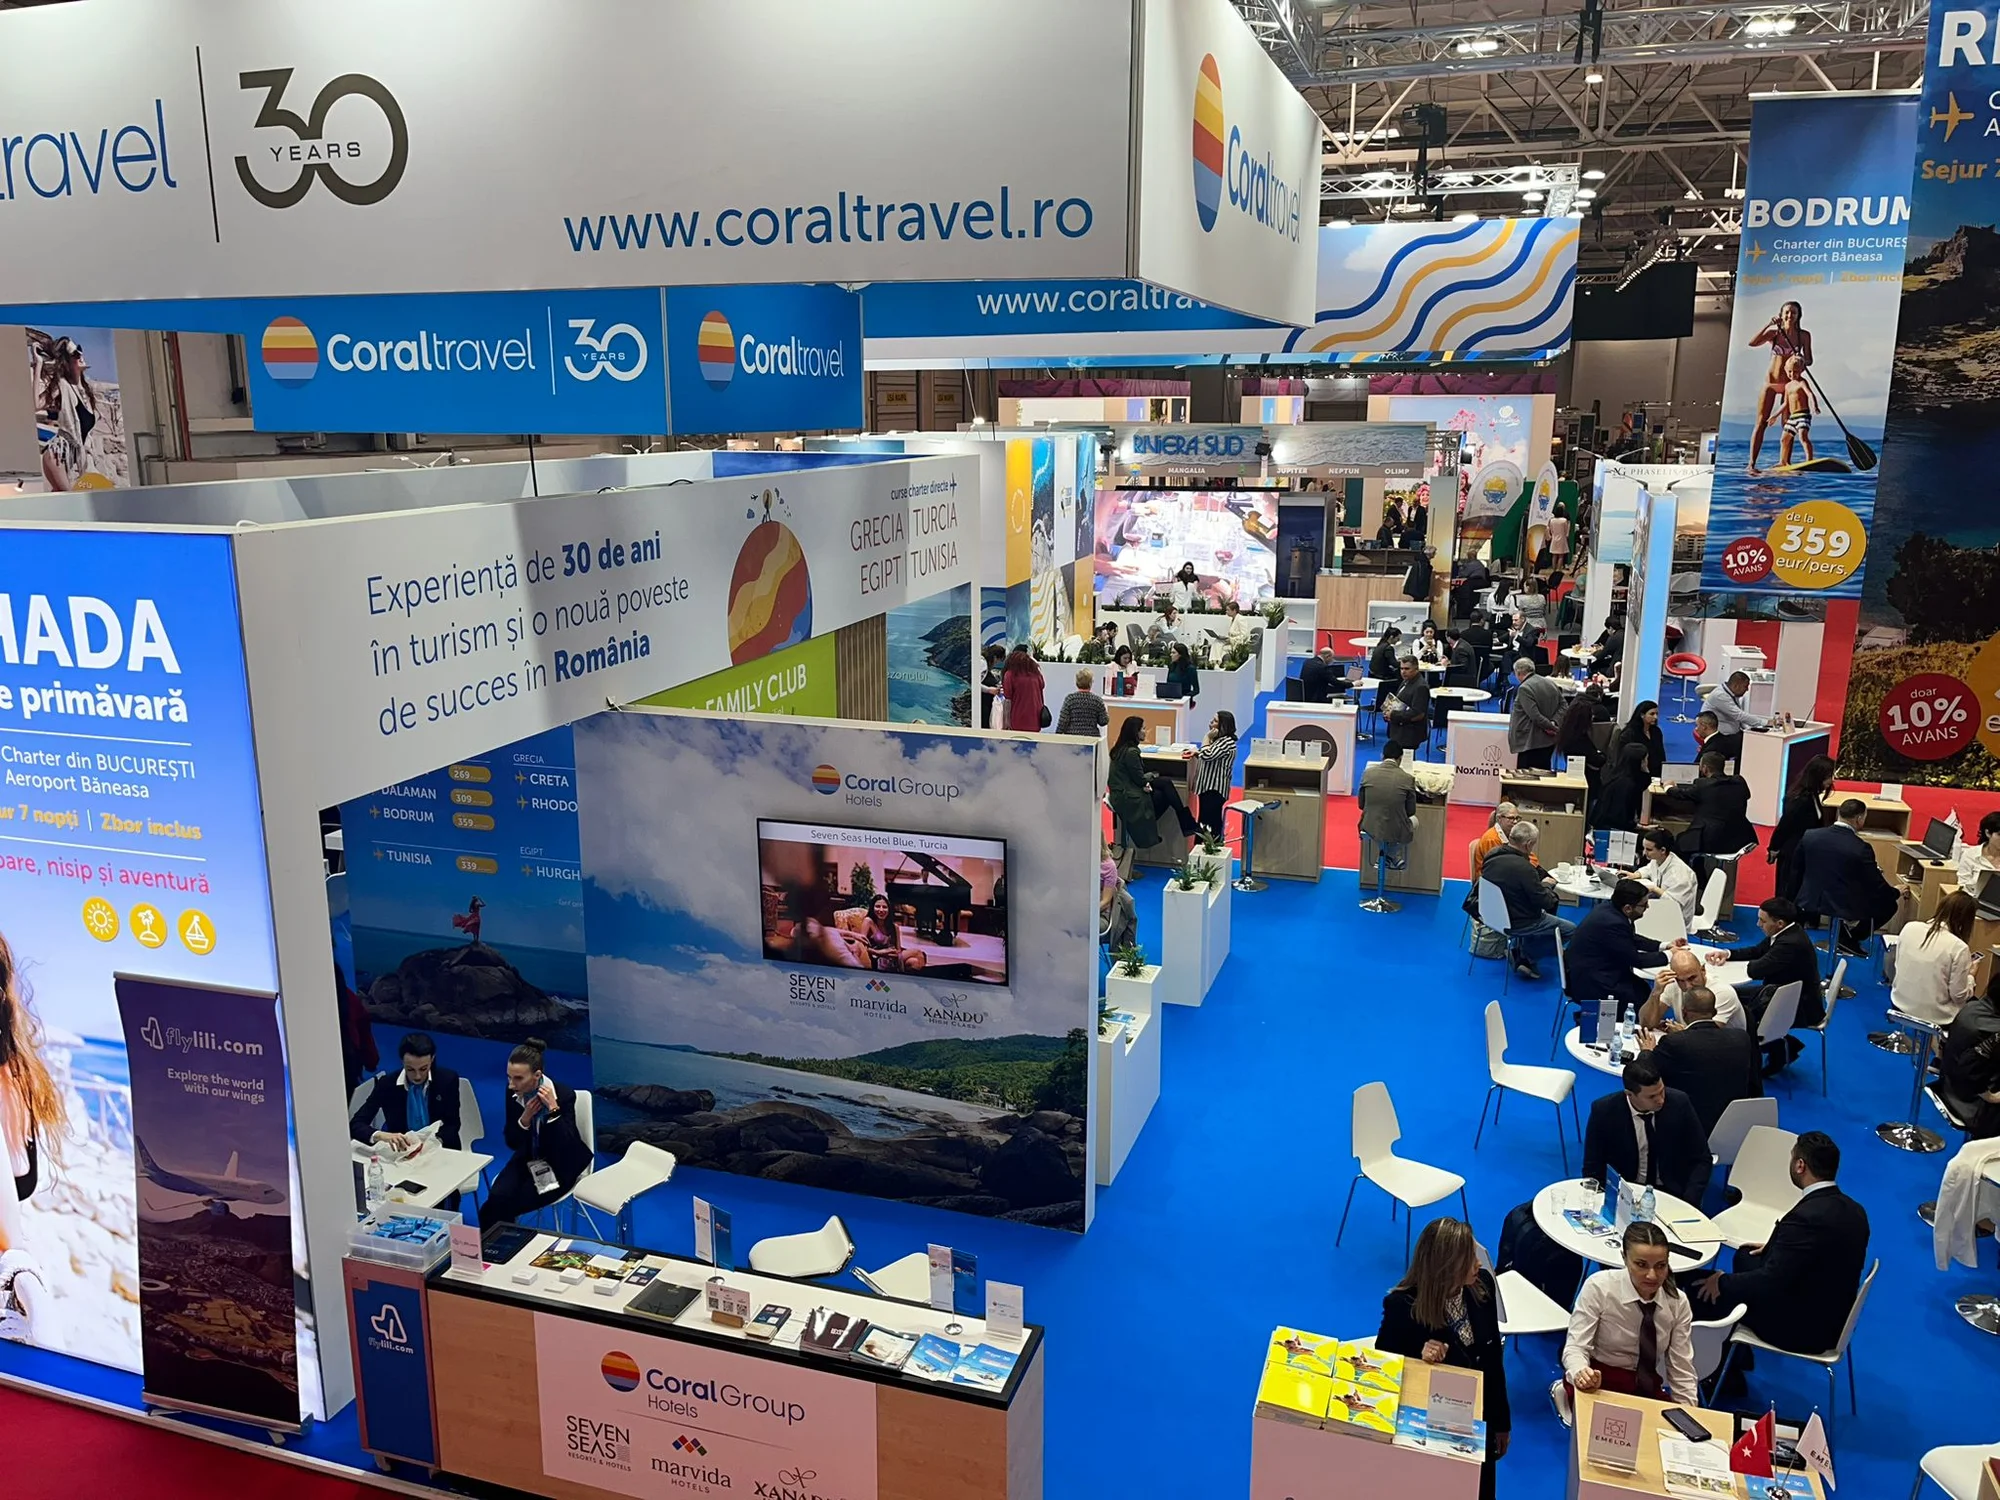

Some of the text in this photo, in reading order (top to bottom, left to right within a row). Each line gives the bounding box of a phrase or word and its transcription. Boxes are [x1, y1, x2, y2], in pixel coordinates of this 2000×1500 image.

[0, 98, 177, 200] ravel
[270, 140, 362, 163] YEARS
[1921, 160, 1988, 184] Sejur
[562, 186, 1094, 252] www.coraltravel.ro
[1773, 238, 1820, 250] Charter
[1824, 237, 1844, 249] din
[1771, 251, 1883, 264] Aeroport Băneasa
[326, 327, 535, 373] Coraltravel
[581, 352, 626, 362] YEARS
[740, 334, 845, 379] Coraltravel
[1203, 434, 1245, 457] SUD
[1328, 467, 1360, 475] NEPTUN
[1384, 467, 1410, 475] OLIMP
[890, 480, 949, 501] curse charter directe
[850, 501, 958, 552] GRECIA TURCIA
[1786, 511, 1815, 524] de la
[1779, 524, 1852, 559] 359
[860, 540, 958, 595] EGIPT TUNISIA
[1725, 547, 1767, 569] 10%
[1775, 556, 1848, 577] eur/pers.
[367, 530, 661, 618] Experiență de 30 de ani
[1732, 563, 1763, 577] AVANS
[370, 576, 689, 677] în turism și o nouă poveste
[379, 630, 651, 736] de succes în România
[766, 663, 807, 702] CLUB
[1910, 686, 1938, 700] doar
[20, 679, 189, 724] primăvară
[1886, 694, 1968, 733] 10%
[1902, 725, 1959, 746] AVANS
[1, 745, 196, 782] Charter din BUCUREȘTI
[513, 753, 545, 764] GRECIA
[5, 770, 150, 799] Aeroport Băneasa
[453, 770, 470, 779] 269
[529, 772, 570, 788] CRETA
[381, 785, 437, 800] DALAMAN
[845, 794, 882, 808] Hotels
[18, 803, 29, 821] 7
[32, 808, 80, 831] nopți
[100, 812, 145, 834] Zbor
[147, 817, 203, 840] inclus
[383, 807, 435, 823] BODRUM
[811, 829, 839, 840] Seven
[841, 832, 862, 843] Seas
[864, 834, 890, 846] Hotel
[919, 839, 948, 850] Turcia
[387, 850, 433, 865] TUNISIA
[520, 846, 543, 857] EGIPT
[46, 856, 93, 885] nisip
[98, 862, 113, 887] și
[119, 867, 209, 894] aventură
[536, 866, 582, 882] HURGH
[789, 973, 836, 991] SEVEN
[789, 987, 826, 1003] SEAS
[850, 997, 908, 1015] marvida
[863, 1011, 892, 1020] HOTELS
[923, 1006, 984, 1024] XANADU
[165, 1026, 264, 1056] flylili.com
[167, 1067, 264, 1091] Explore the world
[184, 1082, 265, 1105] with our wings
[367, 1336, 414, 1355] flylili.com
[648, 1394, 698, 1419] Hotels
[566, 1415, 631, 1445] SEVEN
[567, 1433, 617, 1460] SEAS
[1594, 1434, 1632, 1448] EMELDA
[568, 1451, 597, 1464] RESORTS
[606, 1461, 632, 1472] HOTELS
[651, 1457, 732, 1489] marvida
[671, 1478, 711, 1494] HOTELS
